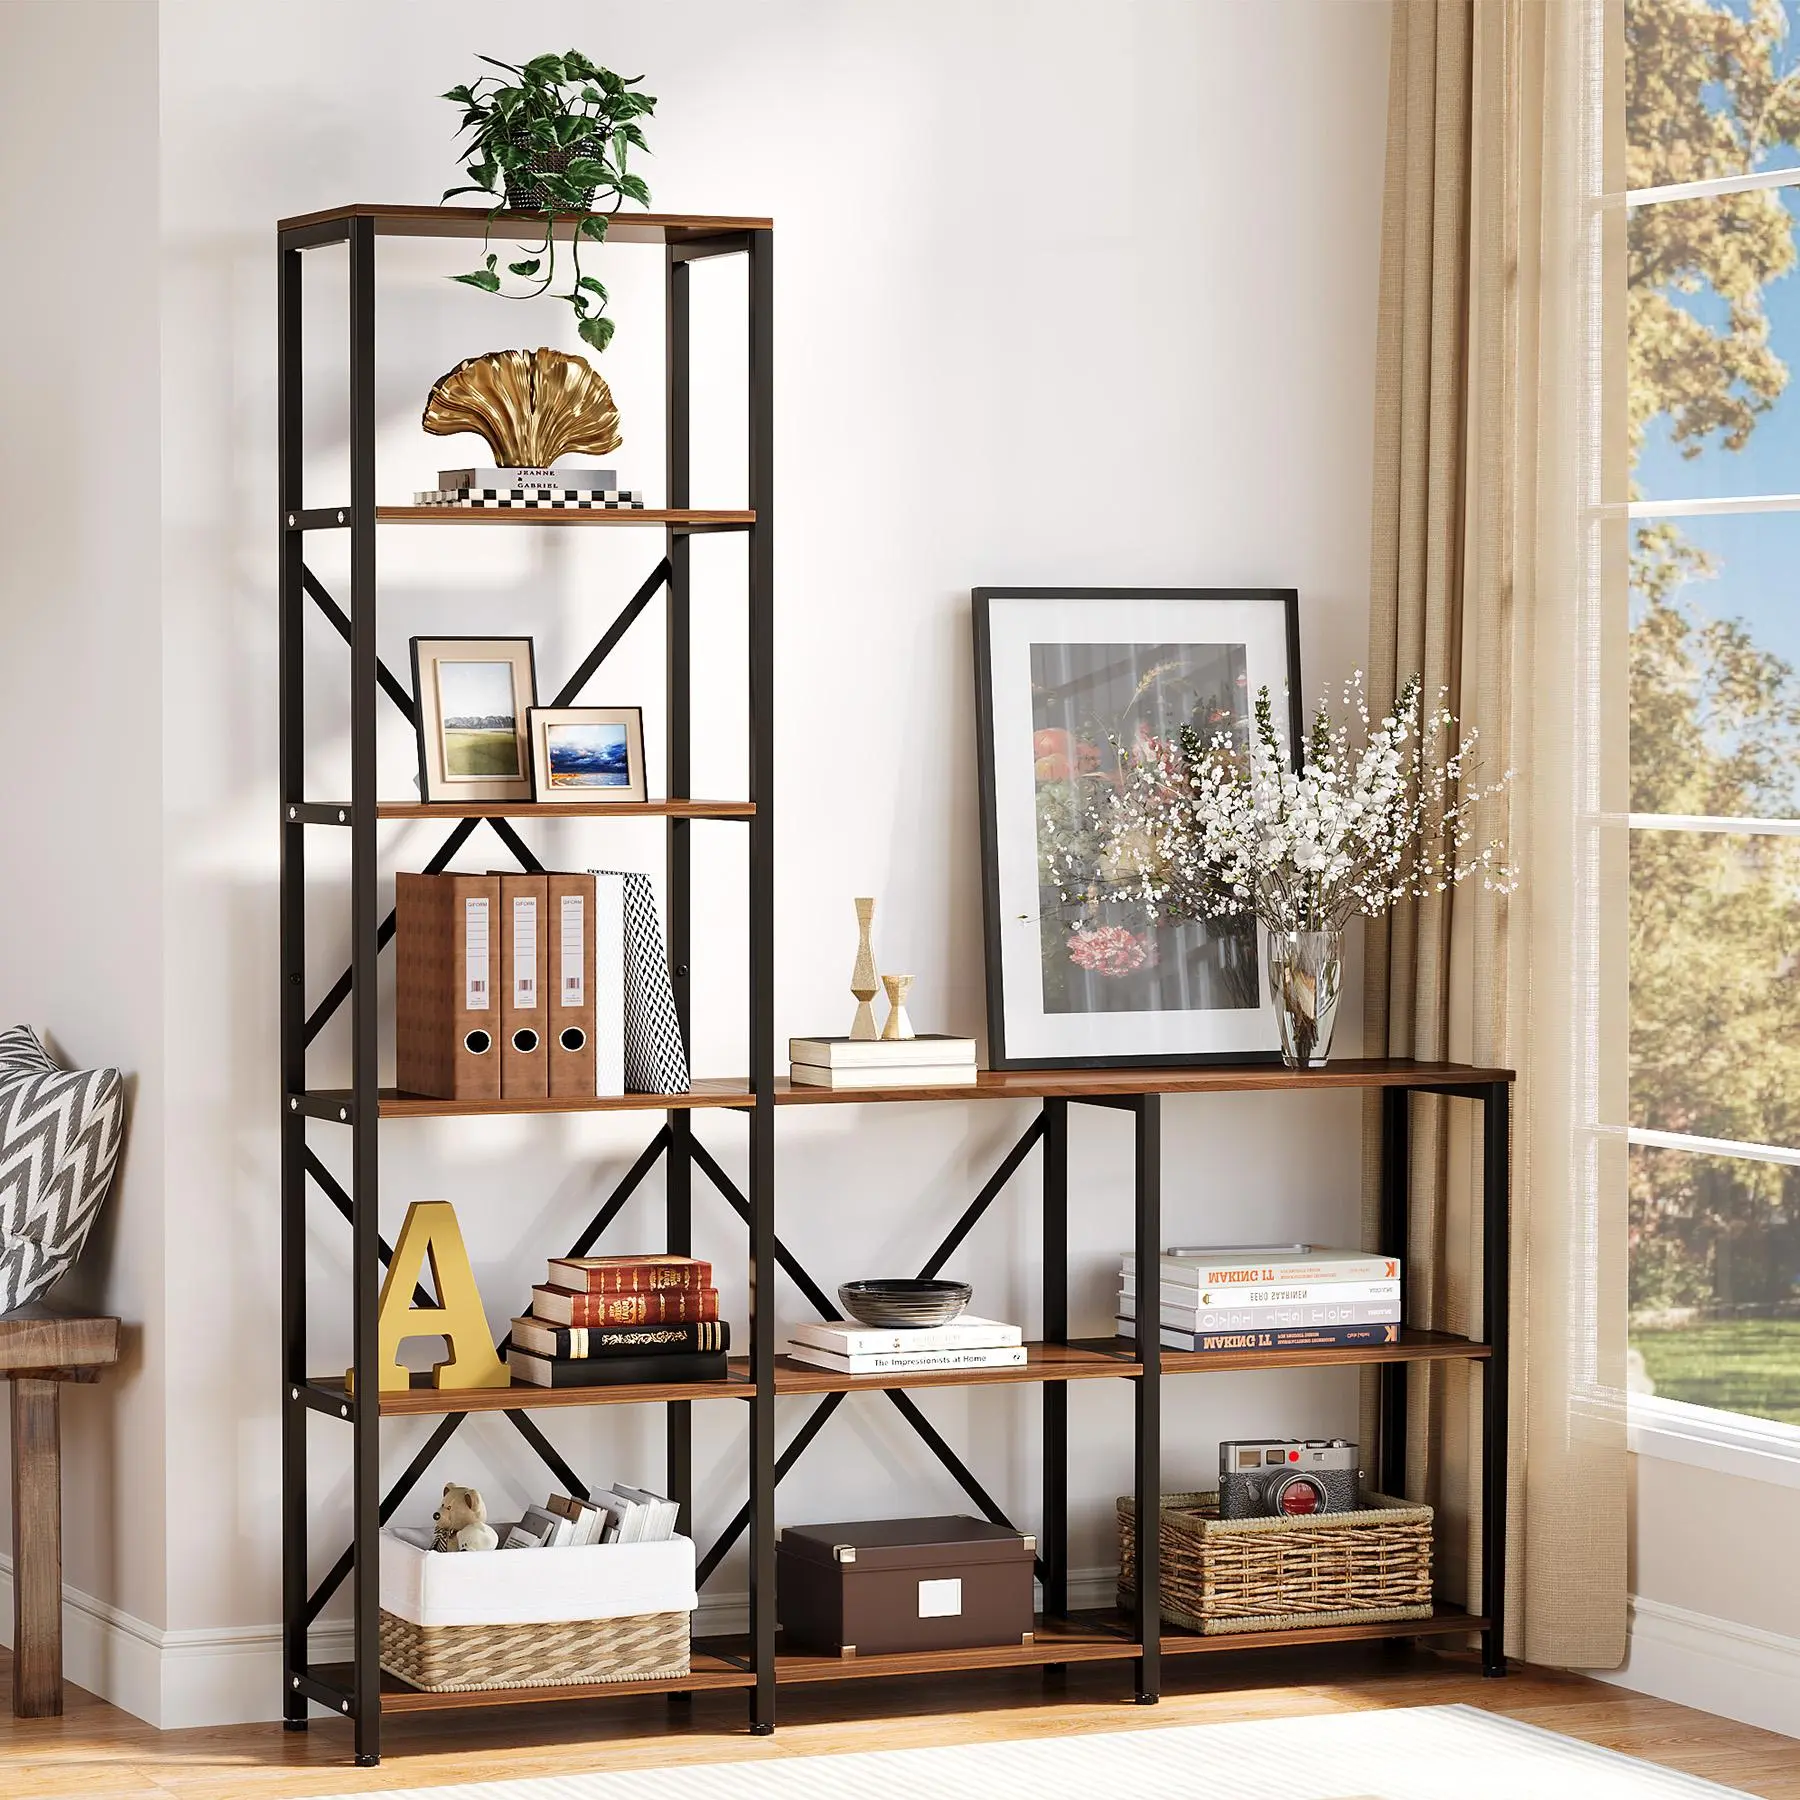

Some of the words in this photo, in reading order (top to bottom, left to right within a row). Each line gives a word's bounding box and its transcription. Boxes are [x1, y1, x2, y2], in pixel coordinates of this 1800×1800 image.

[874, 1358, 889, 1367] The
[891, 1355, 950, 1367] Impressionists
[952, 1354, 961, 1363] at
[963, 1354, 987, 1363] Home
